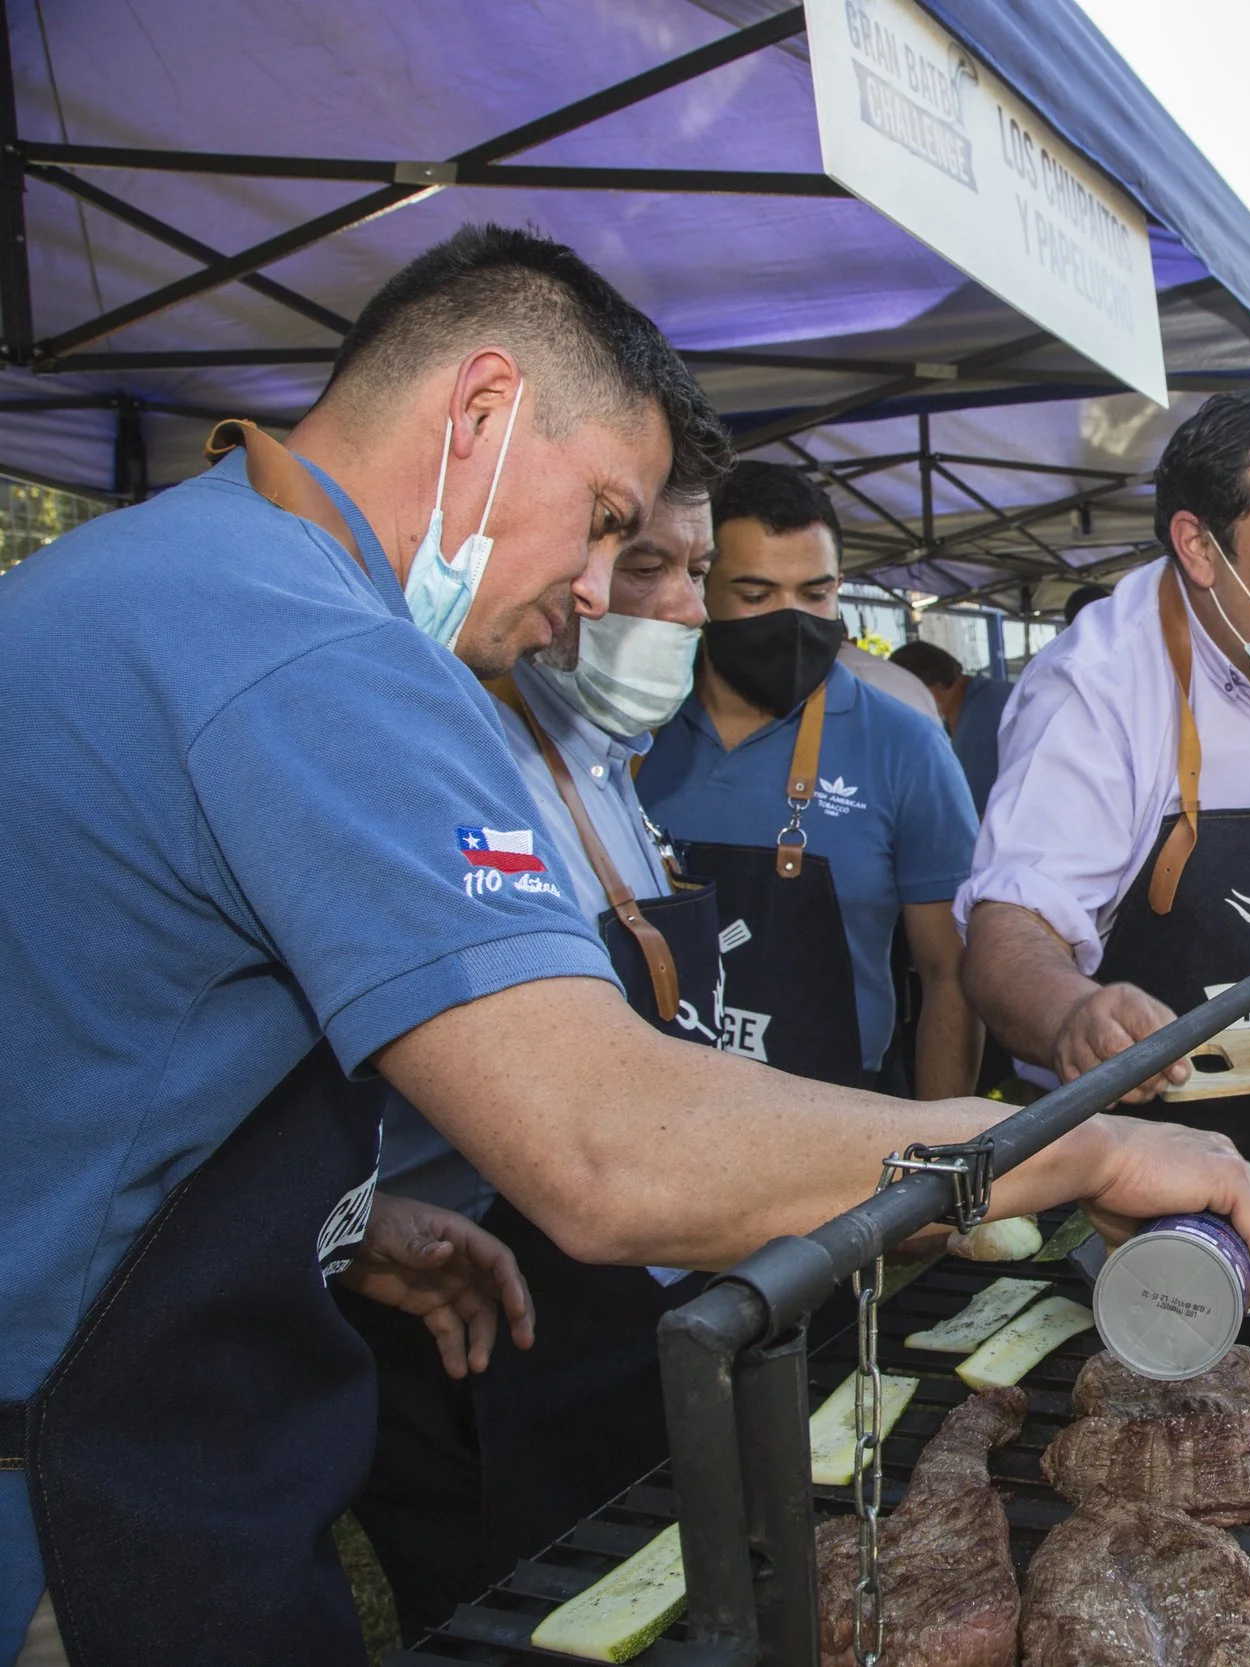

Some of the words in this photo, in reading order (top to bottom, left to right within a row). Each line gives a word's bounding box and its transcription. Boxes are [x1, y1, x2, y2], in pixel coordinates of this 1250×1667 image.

[845, 0, 900, 79] GRAN
[866, 77, 969, 183] CHALLENGE
[997, 104, 1038, 192] LOS
[1016, 191, 1030, 256] Y
[1034, 207, 1134, 335] PAPELUCHO
[819, 800, 850, 814] TOBACCO
[830, 795, 867, 809] AMERICAN
[464, 869, 502, 897] 110
